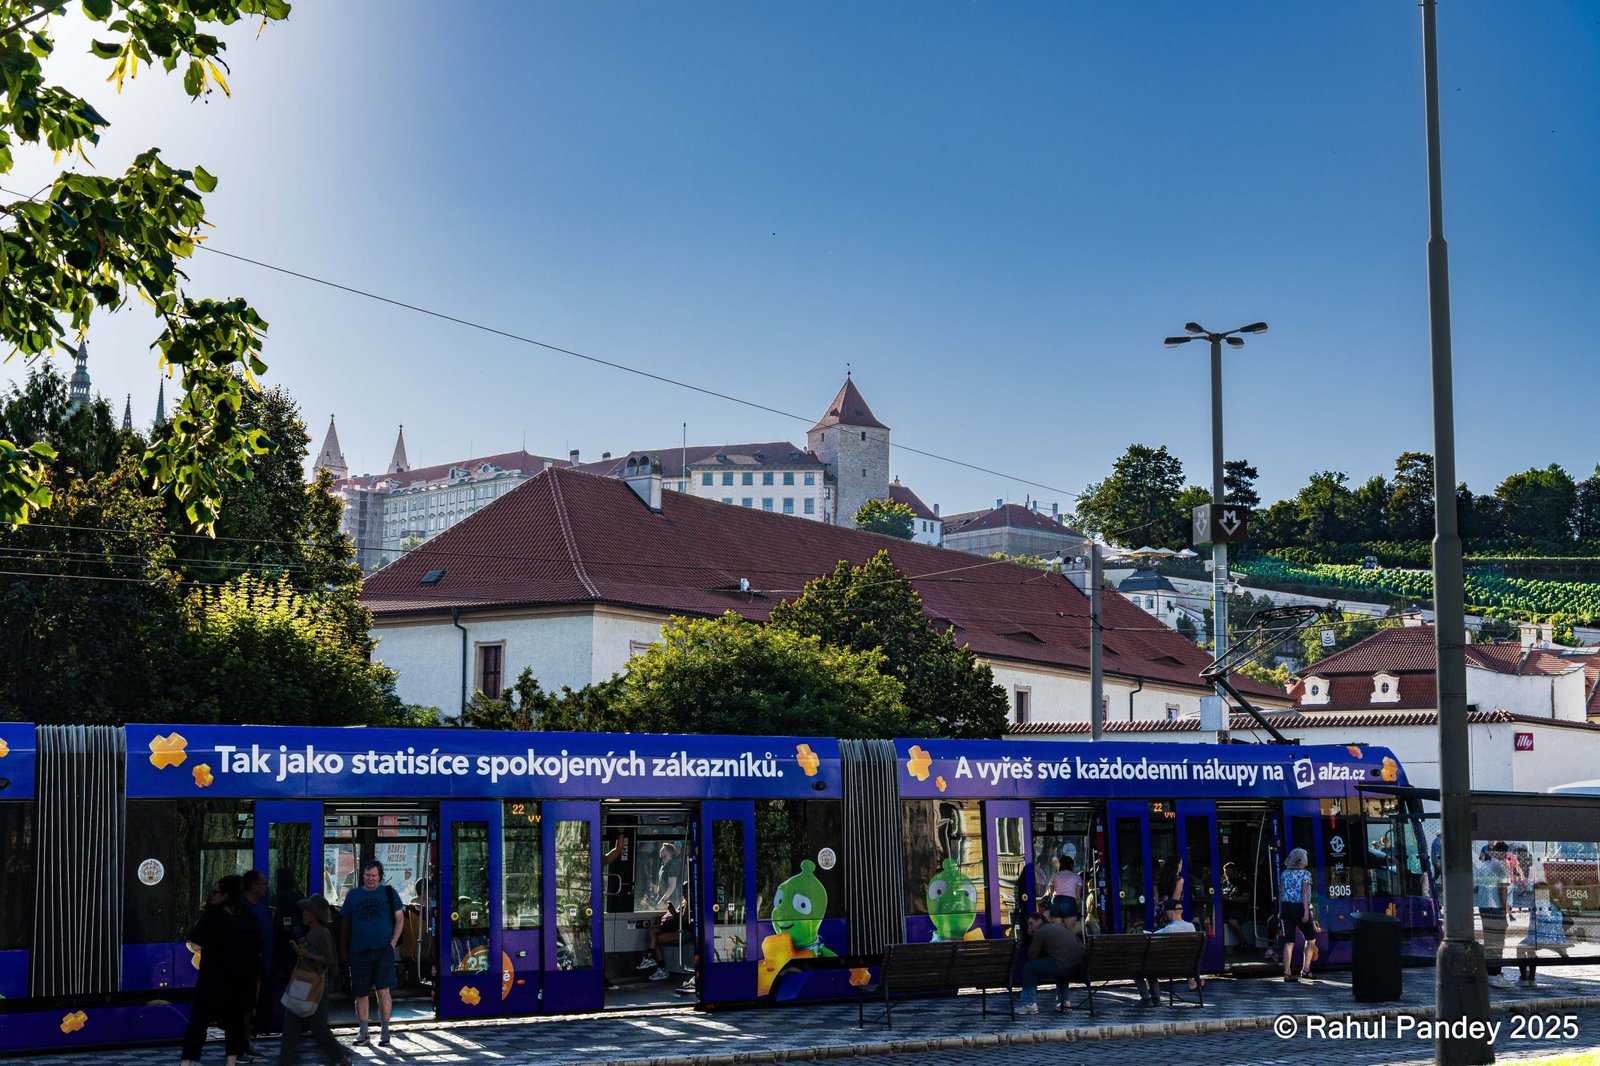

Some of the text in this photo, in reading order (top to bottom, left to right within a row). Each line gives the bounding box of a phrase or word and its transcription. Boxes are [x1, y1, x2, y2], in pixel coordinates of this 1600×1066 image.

[1517, 735, 1533, 749] illy
[214, 744, 784, 784] Tak jako statisíce spokojených zákazníků.
[954, 756, 973, 778] A
[976, 756, 1033, 785] vyřeš
[1037, 758, 1071, 779] své
[1076, 756, 1188, 780] každodenní
[1192, 758, 1258, 786] nákupy
[1263, 764, 1284, 780] na
[1318, 762, 1365, 781] alza.cz
[512, 804, 525, 815] 22
[1153, 803, 1163, 812] 22
[1329, 885, 1351, 897] 9305
[1566, 889, 1588, 899] 8264
